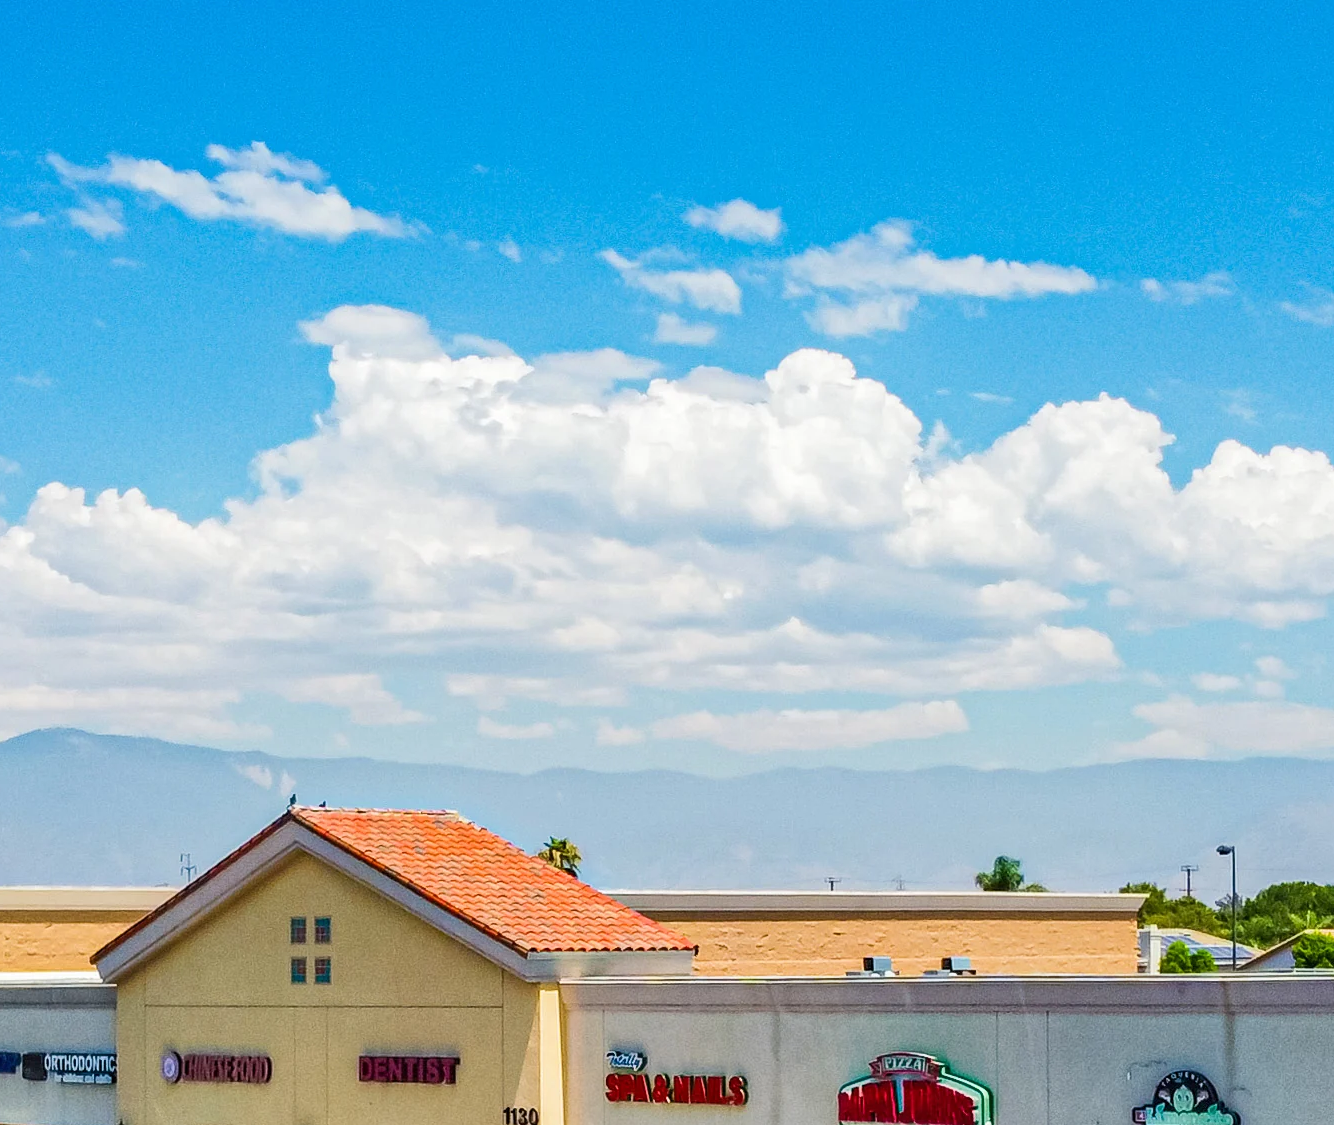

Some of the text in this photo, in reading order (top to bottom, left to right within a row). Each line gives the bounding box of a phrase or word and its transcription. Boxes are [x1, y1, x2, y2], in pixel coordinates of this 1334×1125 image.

[359, 1056, 460, 1084] DENTIST
[605, 1051, 648, 1072] Totally
[884, 1056, 925, 1071] PIZZA
[605, 1073, 748, 1106] SPA & NAILS
